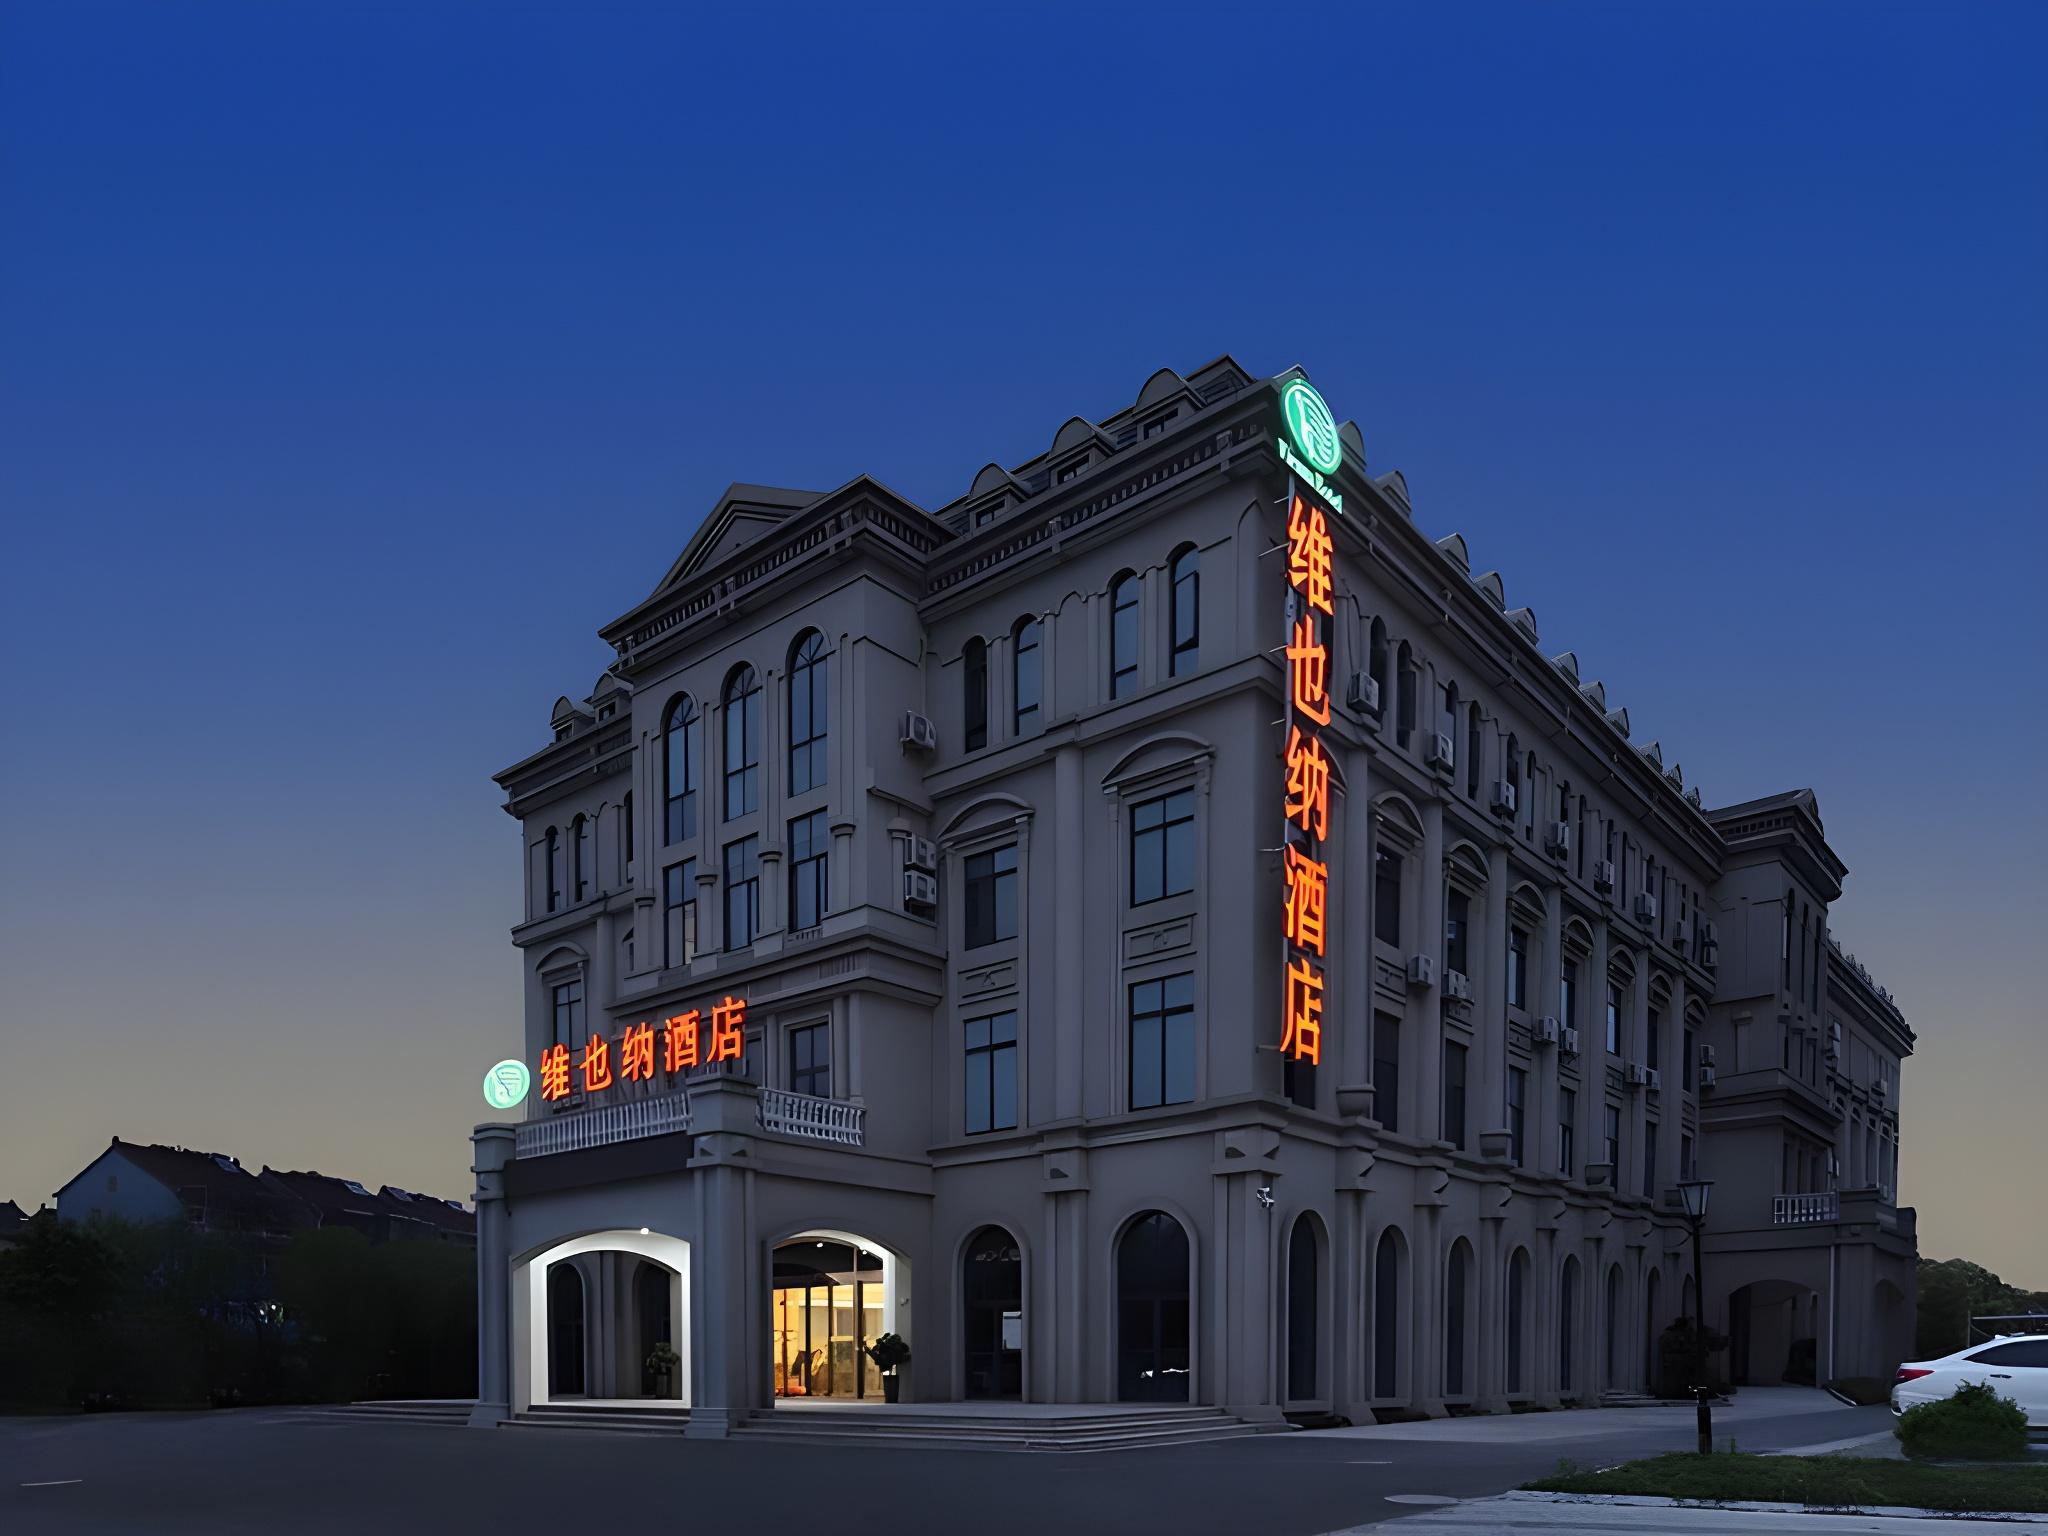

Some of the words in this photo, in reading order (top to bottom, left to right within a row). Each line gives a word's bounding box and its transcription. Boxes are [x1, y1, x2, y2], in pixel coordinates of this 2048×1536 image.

[1281, 495, 1333, 1065] 维也纳酒店
[540, 996, 746, 1100] 维也纳酒店
